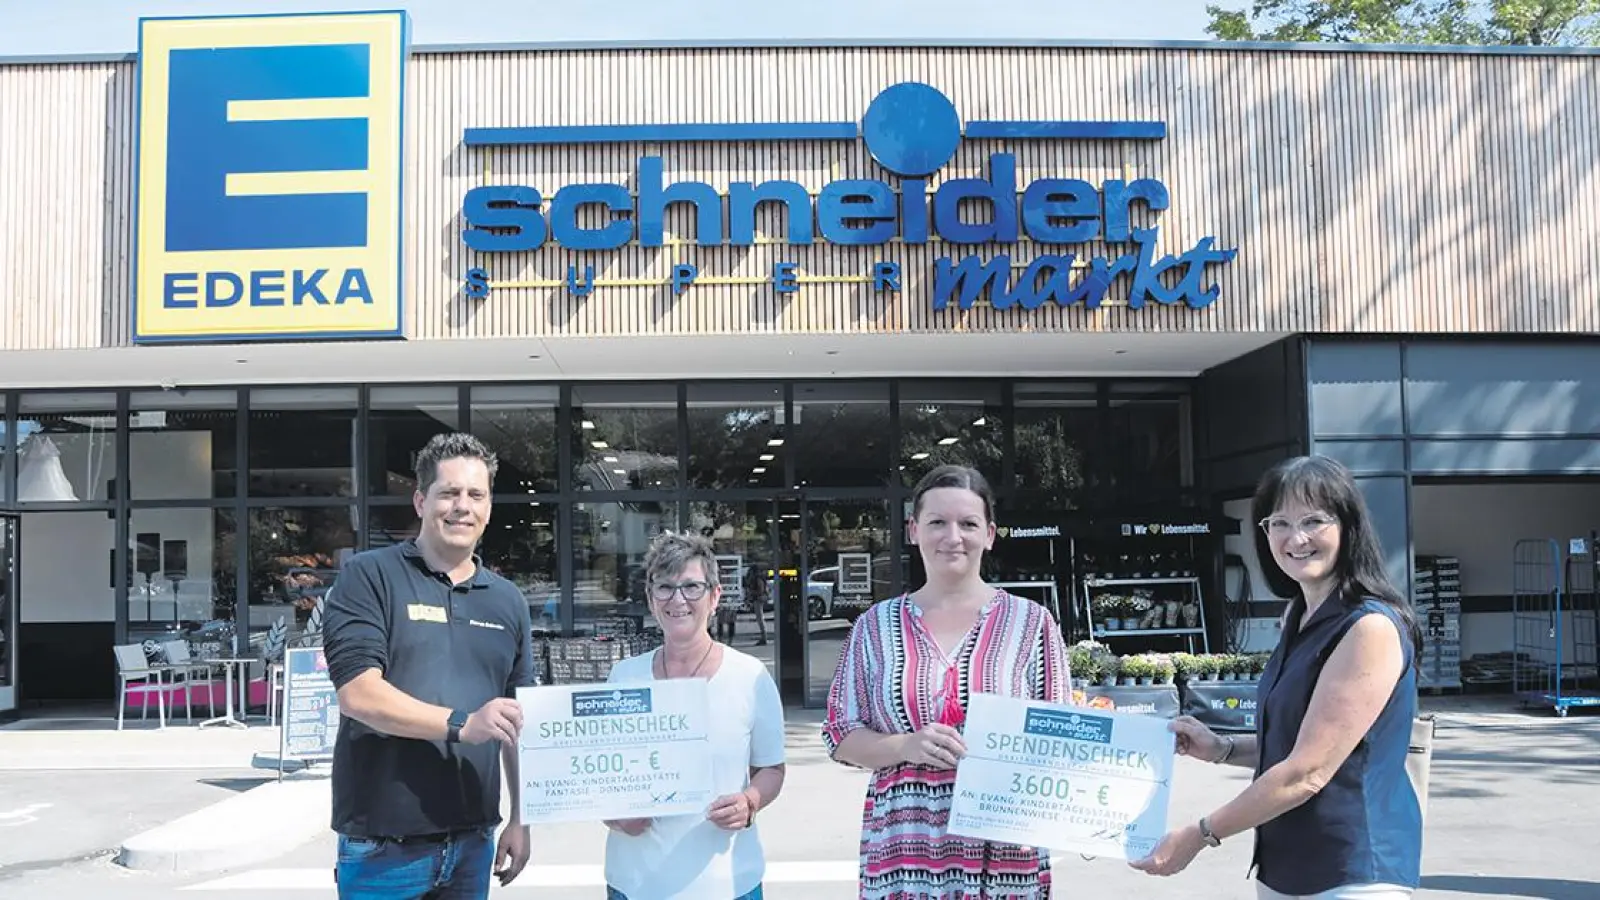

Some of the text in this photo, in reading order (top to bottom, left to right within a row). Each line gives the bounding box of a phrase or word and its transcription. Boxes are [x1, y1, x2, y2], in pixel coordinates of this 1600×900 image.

[462, 153, 1169, 251] schneider
[933, 226, 1238, 311] markt
[163, 268, 374, 309] EDEKA
[1133, 525, 1147, 535] Wir
[1211, 699, 1225, 710] Wir
[539, 713, 690, 739] SPENDENSCHECK
[1028, 716, 1101, 734] schneider
[650, 751, 661, 770] €
[986, 732, 1148, 770] SPENDENSCHECK
[545, 786, 591, 797] FANTASIE
[1097, 785, 1110, 806] €
[979, 802, 1059, 821] BRUNNENWIESE
[1069, 814, 1138, 832] ECKERSDORF
